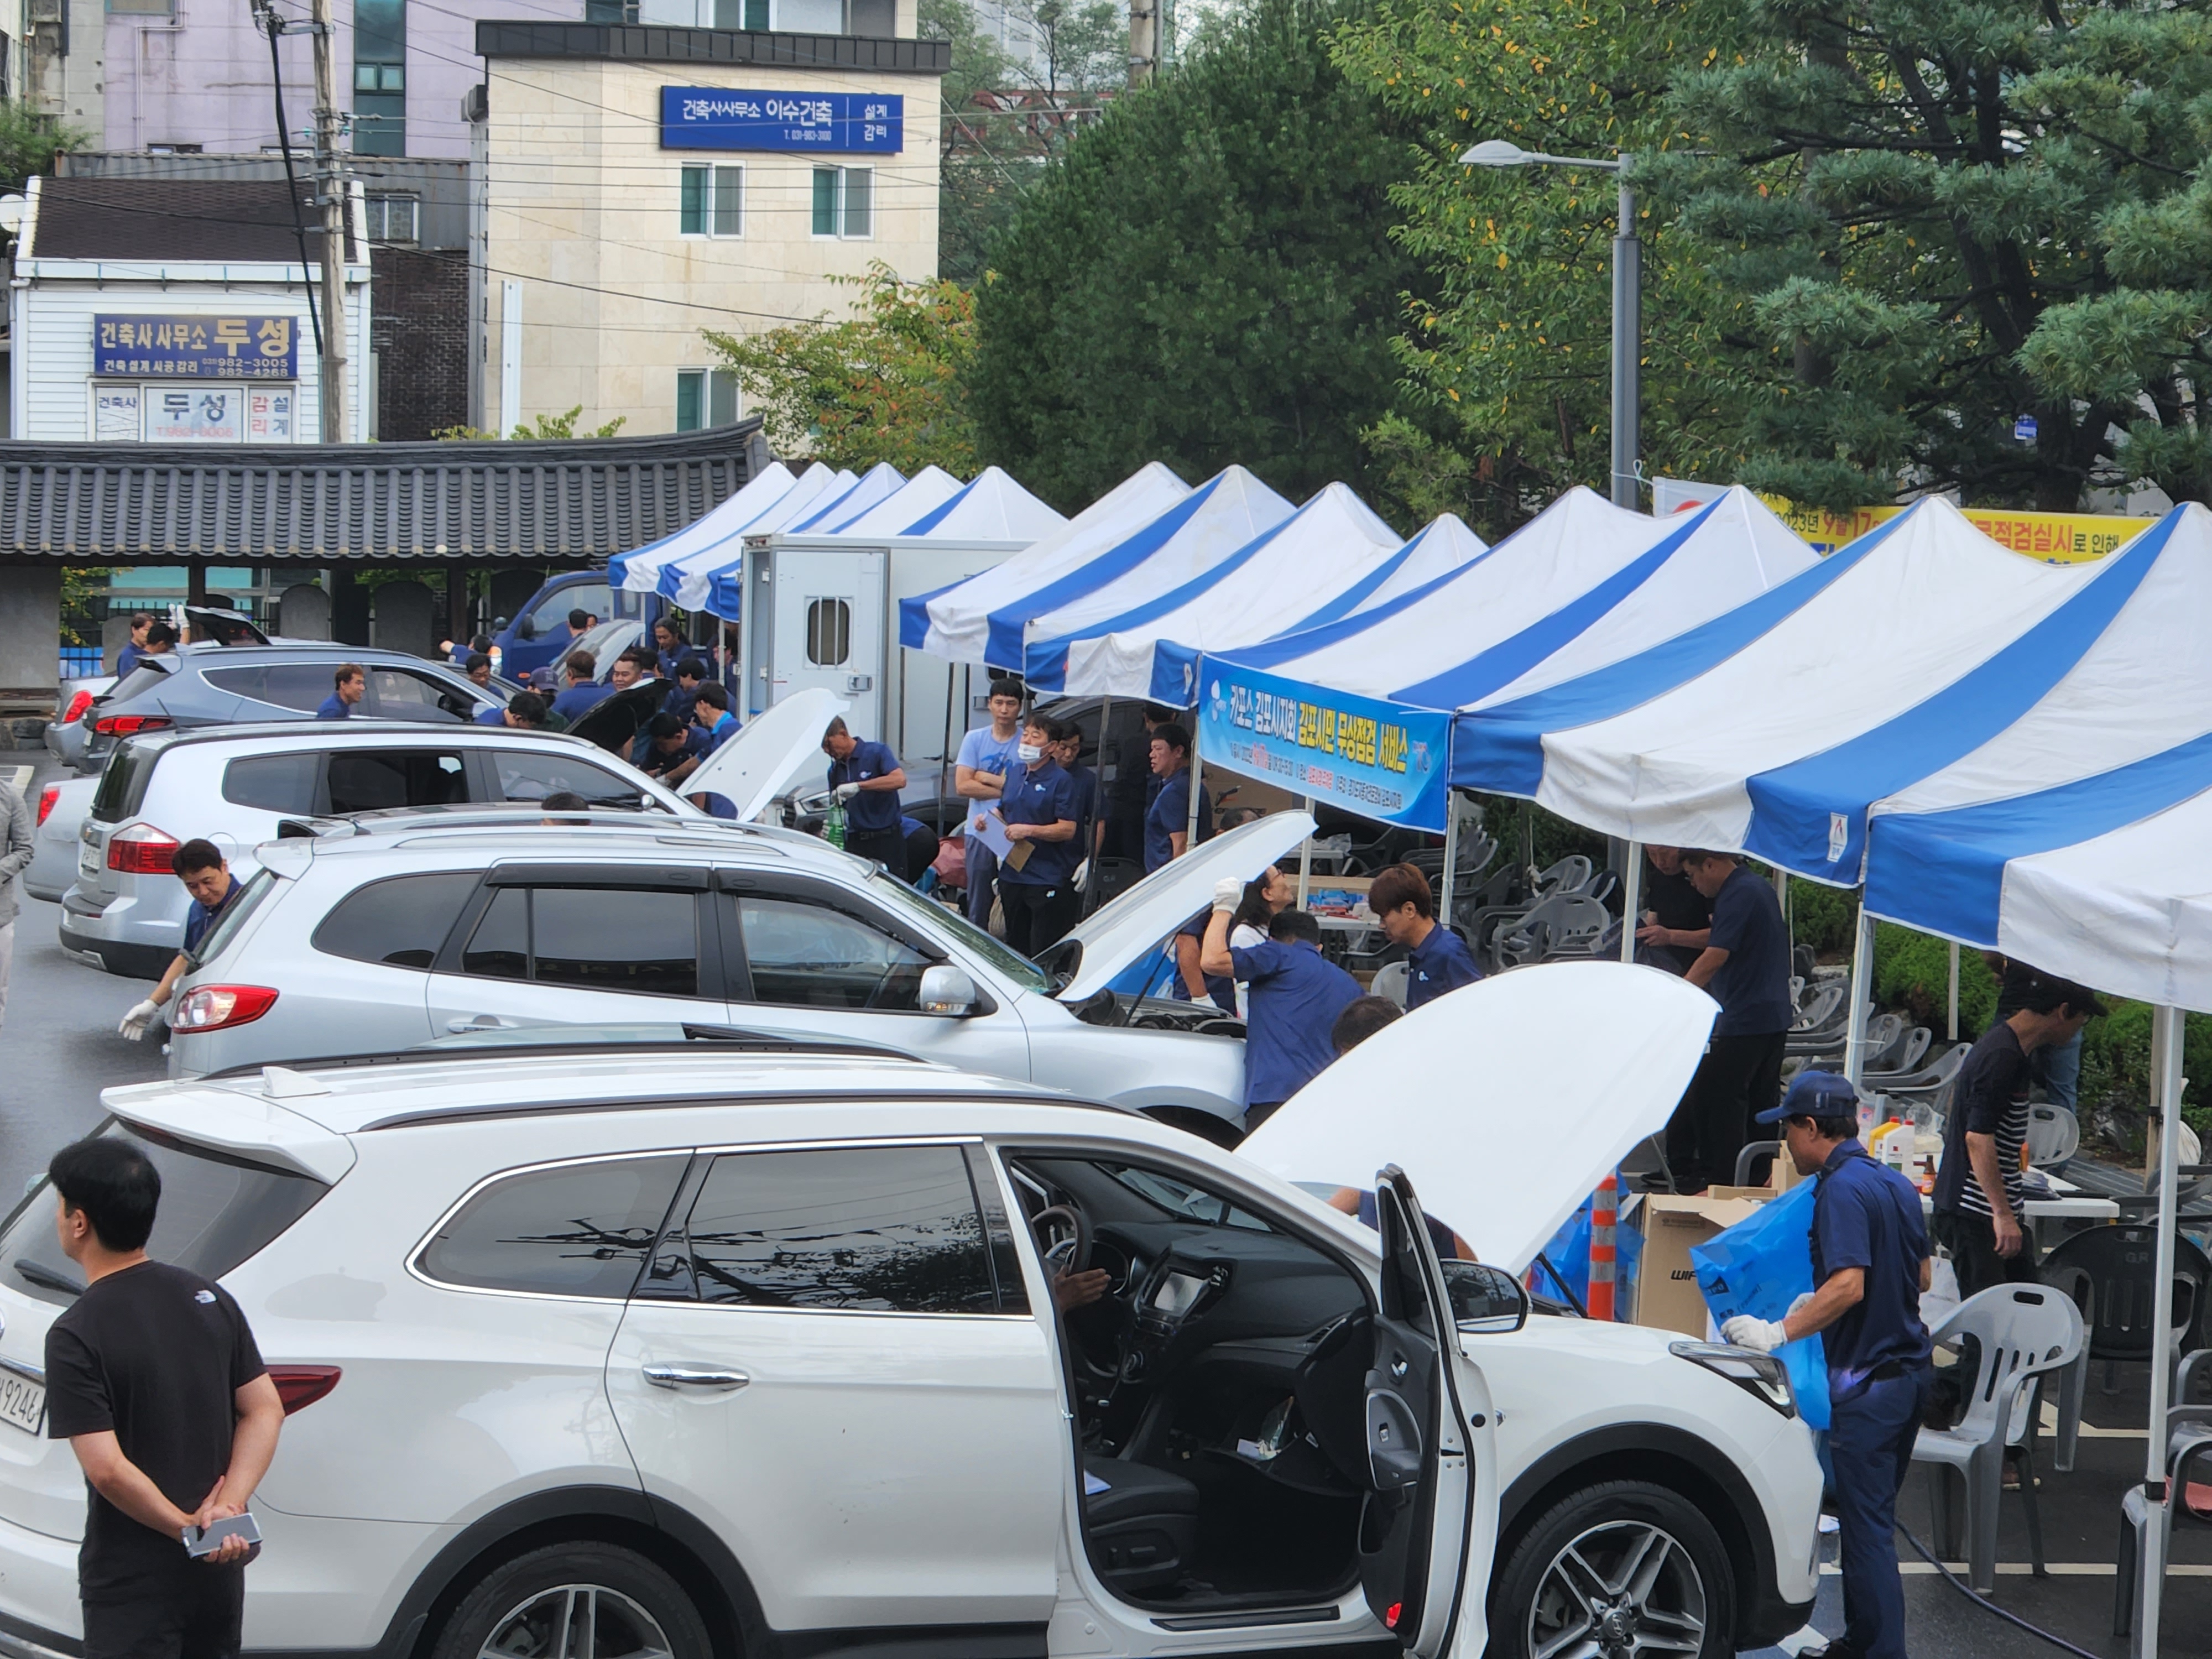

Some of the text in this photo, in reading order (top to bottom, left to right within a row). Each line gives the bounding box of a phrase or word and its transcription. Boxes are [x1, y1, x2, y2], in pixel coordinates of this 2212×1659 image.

[683, 99, 832, 127] 건축사사무소 이수건축
[864, 103, 888, 121] 설계
[864, 124, 887, 141] 감리
[101, 319, 290, 357] 건축사사무소 두성
[98, 397, 137, 409] 건축사
[163, 393, 227, 422] 두성
[2091, 534, 2120, 554] 인해
[1229, 685, 1253, 729] 카포스
[1255, 691, 1297, 743] 김포시지회
[1297, 702, 1336, 754] 김포시민
[1337, 712, 1377, 766] 무상점검
[1378, 723, 1408, 773] 서비스
